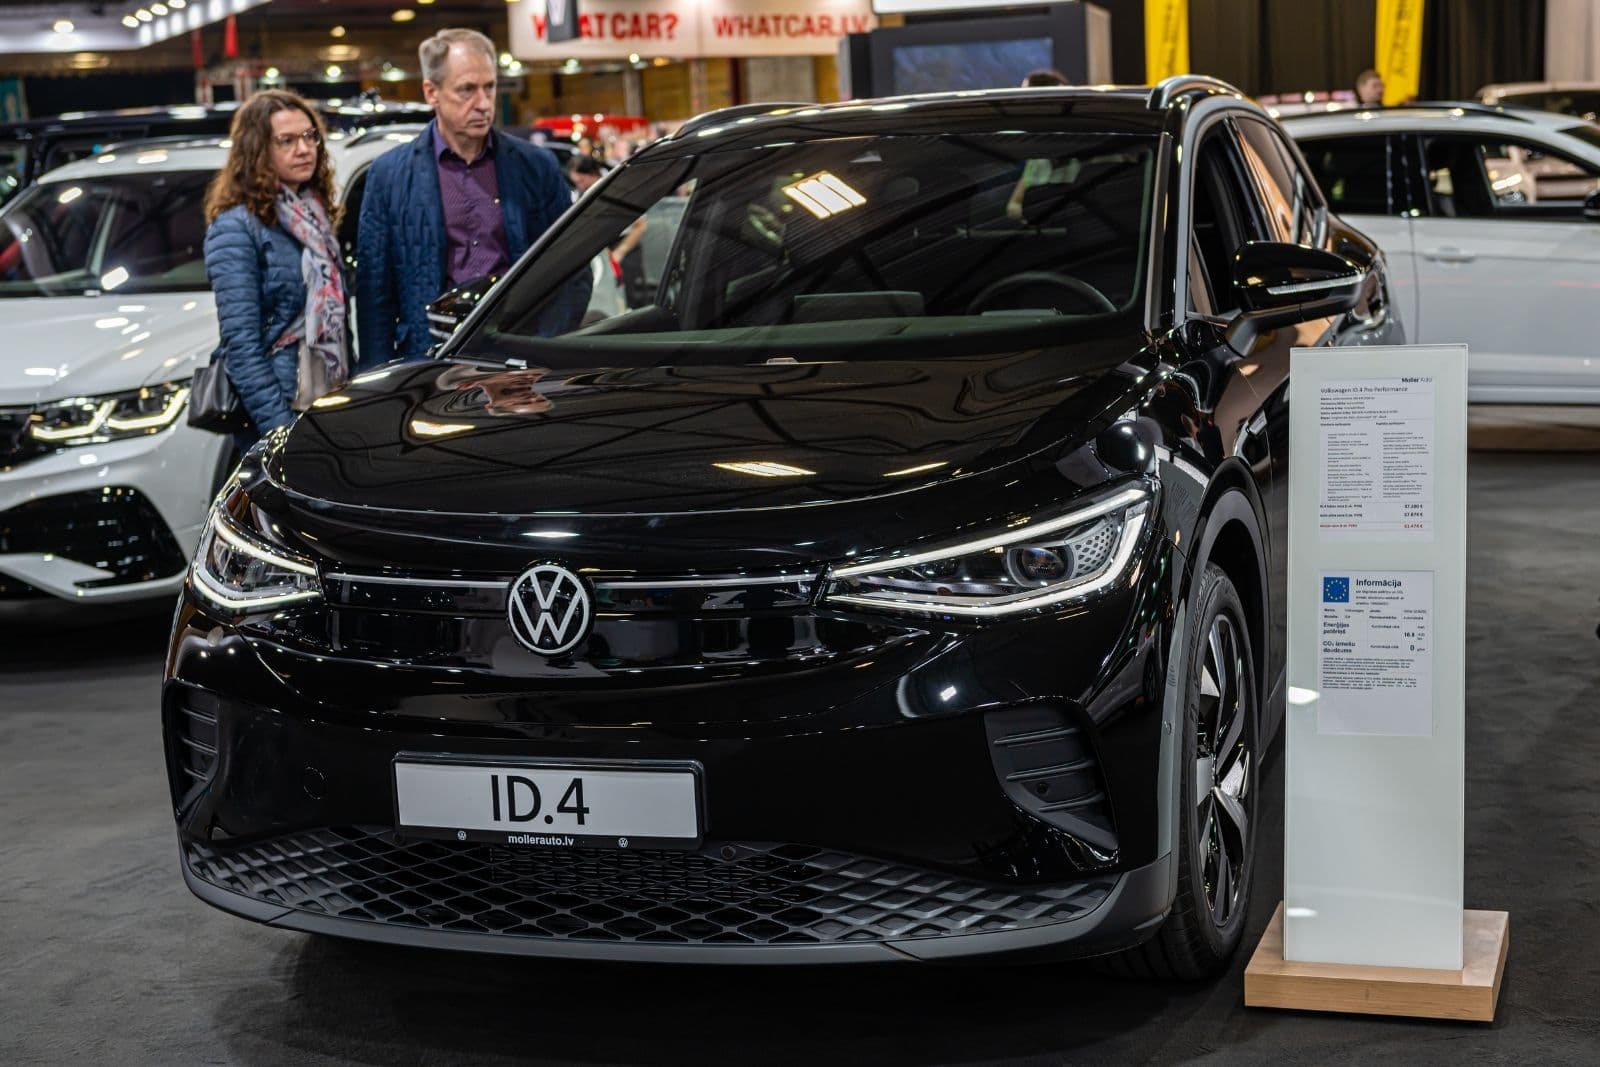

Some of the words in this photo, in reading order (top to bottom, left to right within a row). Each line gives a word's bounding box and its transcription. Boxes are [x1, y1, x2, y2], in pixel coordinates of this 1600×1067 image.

[1355, 578, 1402, 588] Informācija
[490, 774, 590, 826] ID.4
[508, 834, 574, 847] mollerauto.lv
